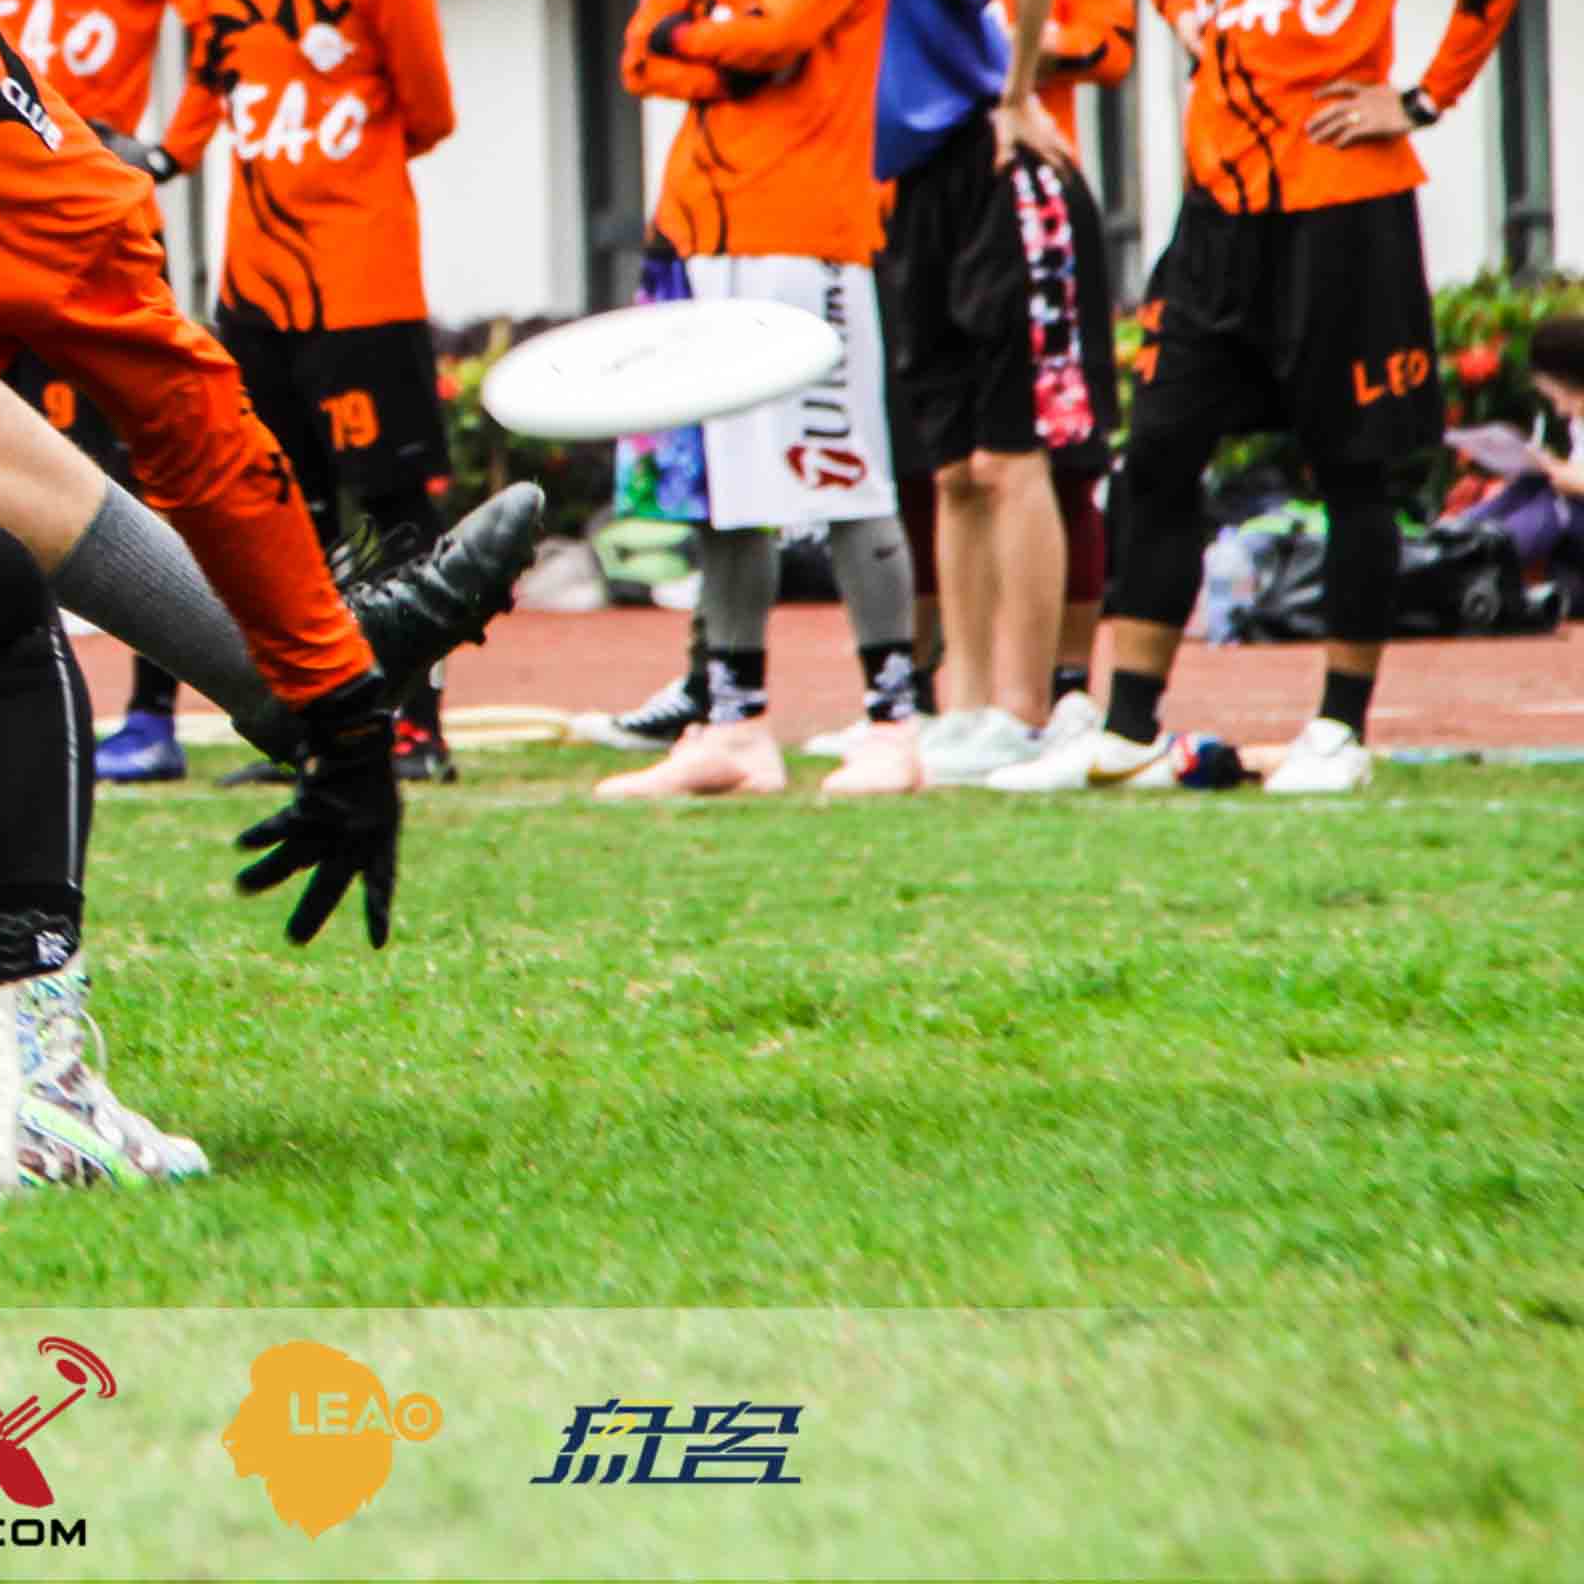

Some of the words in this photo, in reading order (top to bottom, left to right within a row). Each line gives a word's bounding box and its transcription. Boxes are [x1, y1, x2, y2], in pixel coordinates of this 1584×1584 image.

[0, 75, 64, 150] CLUB
[1351, 348, 1429, 406] LEO
[320, 388, 379, 452] 19
